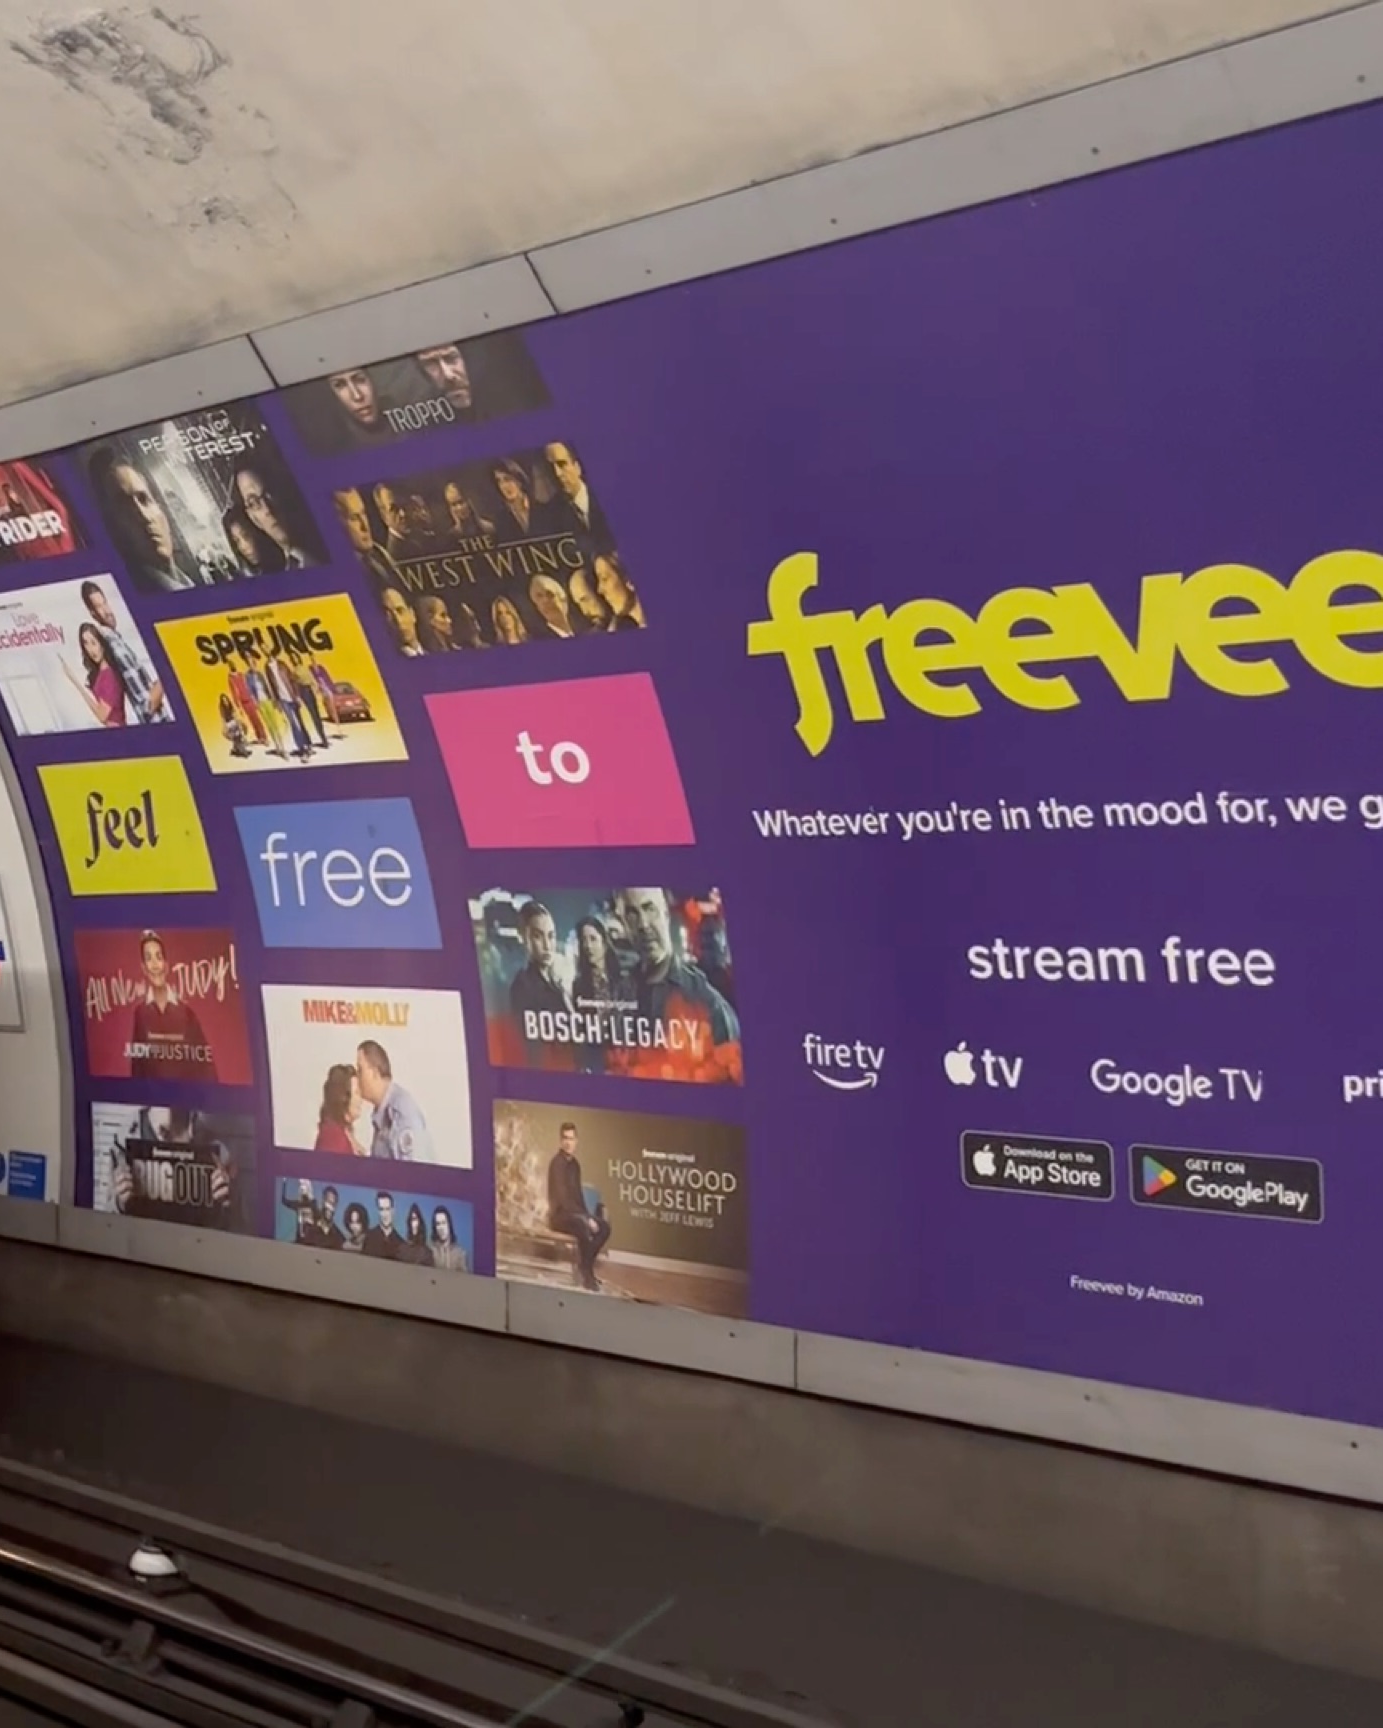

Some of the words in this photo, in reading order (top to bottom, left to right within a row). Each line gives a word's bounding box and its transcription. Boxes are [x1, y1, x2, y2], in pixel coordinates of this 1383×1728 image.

[384, 397, 455, 432] TROPPO
[138, 424, 218, 454] PESON
[168, 432, 255, 467] TEREST
[459, 536, 495, 552] THE
[396, 556, 476, 592] WEST
[485, 538, 583, 578] WING
[196, 618, 332, 667] SPRUNG
[747, 549, 1383, 757] freevee
[516, 730, 590, 784] to
[85, 790, 159, 868] feel
[752, 809, 889, 837] Whatever
[896, 802, 992, 840] you're
[999, 799, 1031, 830] in
[1037, 798, 1094, 829] the
[1103, 792, 1208, 827] mood
[1216, 790, 1278, 828] for,
[1285, 795, 1348, 822] we
[260, 832, 411, 906] free
[967, 938, 1146, 983] stream
[1161, 935, 1277, 986] free
[981, 1048, 1023, 1089] tv
[1090, 1058, 1213, 1107] Google
[1219, 1068, 1263, 1102] TV
[1003, 1144, 1056, 1160] Download
[1059, 1152, 1073, 1161] on
[1075, 1151, 1094, 1164] the
[1004, 1158, 1044, 1185] App
[1047, 1162, 1101, 1187] Store
[1185, 1157, 1210, 1171] GET
[1212, 1160, 1223, 1173] IT
[1224, 1161, 1245, 1174] ON
[607, 1158, 737, 1193] HOLLYWOOD
[619, 1183, 726, 1215] HOUSELIFT
[1070, 1274, 1124, 1294] Freevee
[1127, 1281, 1144, 1300] by
[1146, 1284, 1203, 1306] Amazon
